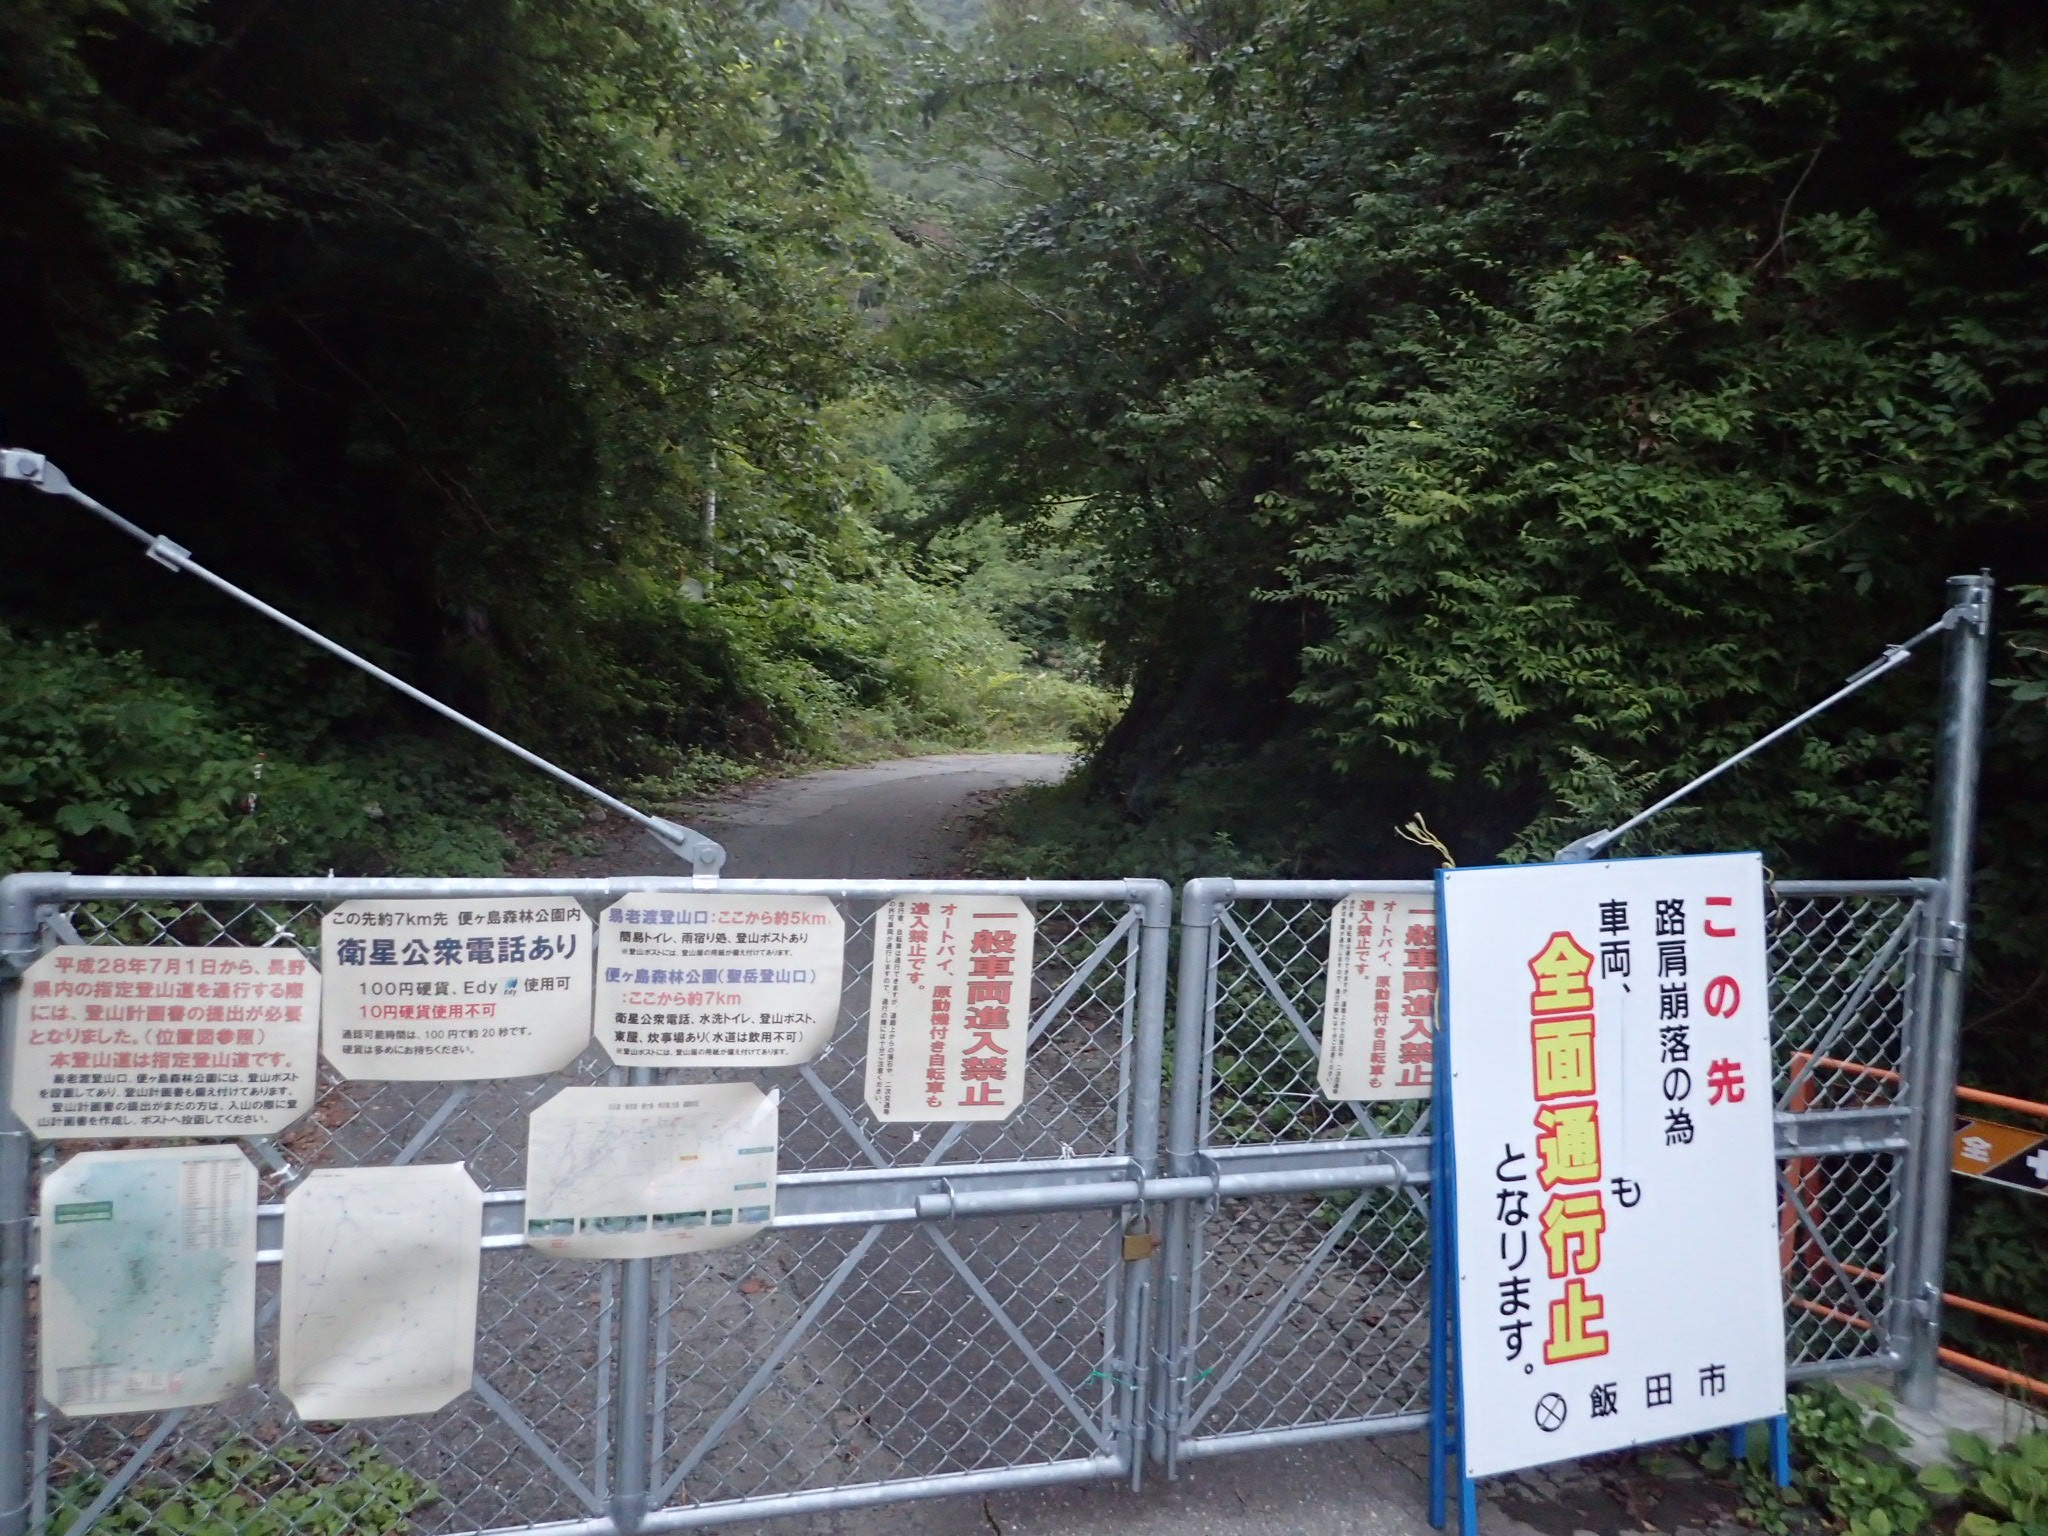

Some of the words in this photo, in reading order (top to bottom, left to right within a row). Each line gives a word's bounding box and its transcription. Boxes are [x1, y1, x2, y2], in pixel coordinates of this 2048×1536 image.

[332, 911, 449, 927] この先約7km先
[337, 934, 577, 967] 衛星公衆電話あり
[907, 902, 931, 990] 進入禁止です。
[360, 1003, 497, 1020] 10円硬貨使用不可
[524, 976, 571, 993] 使用可
[958, 912, 1019, 1107] 一般車両進入禁止
[1655, 898, 1696, 1147] 路肩崩落の為
[1703, 895, 1746, 1107] この先
[1528, 931, 1609, 1366] 全面通行止
[1611, 1176, 1642, 1209] も
[1495, 1143, 1534, 1377] となります。
